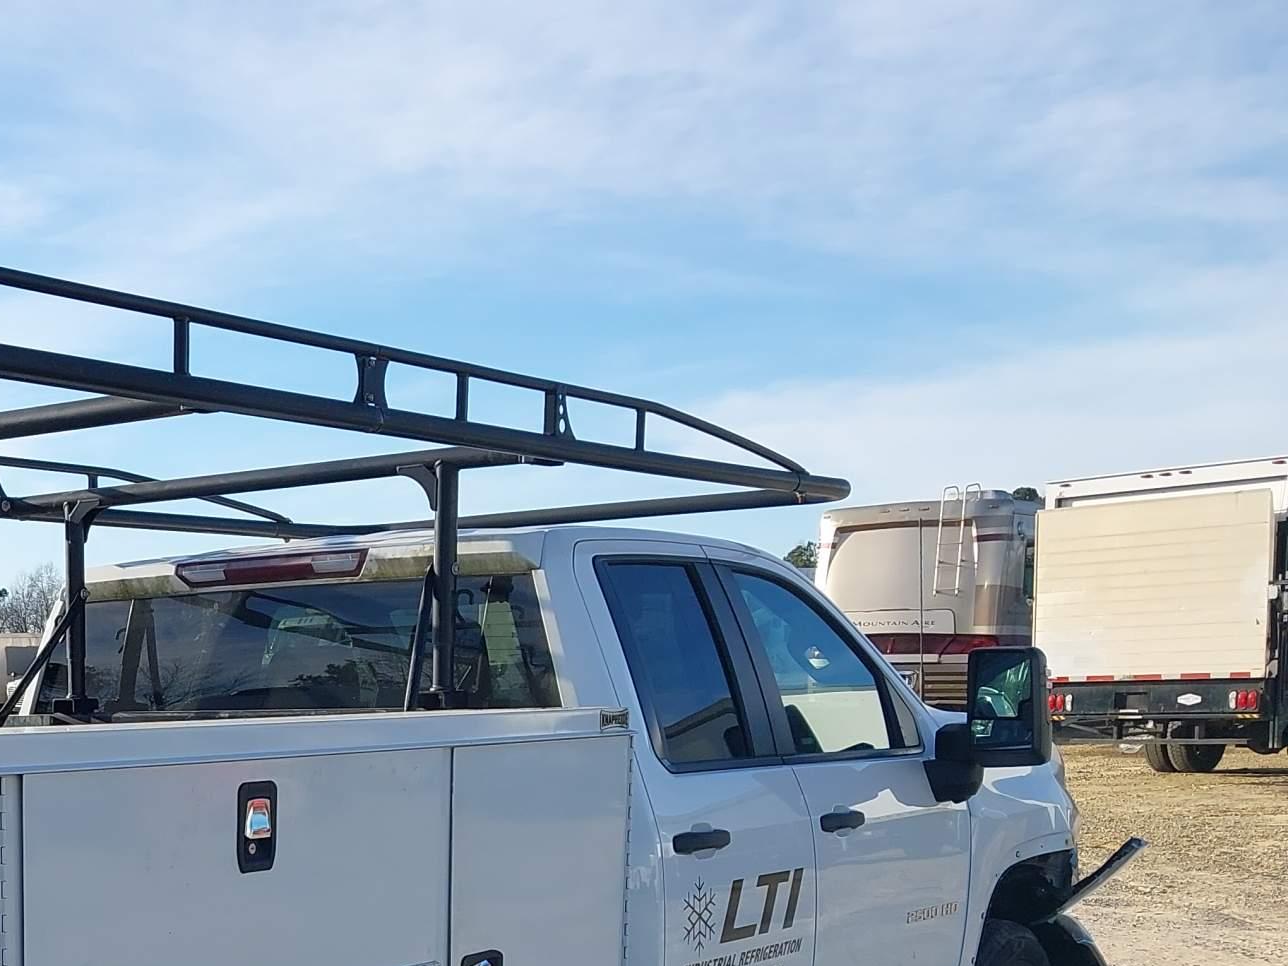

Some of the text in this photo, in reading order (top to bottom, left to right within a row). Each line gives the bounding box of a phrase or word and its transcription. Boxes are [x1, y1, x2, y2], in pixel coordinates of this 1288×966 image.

[911, 619, 935, 627] ARE
[720, 867, 804, 944] LTI
[738, 938, 803, 966] REFRIGERATION
